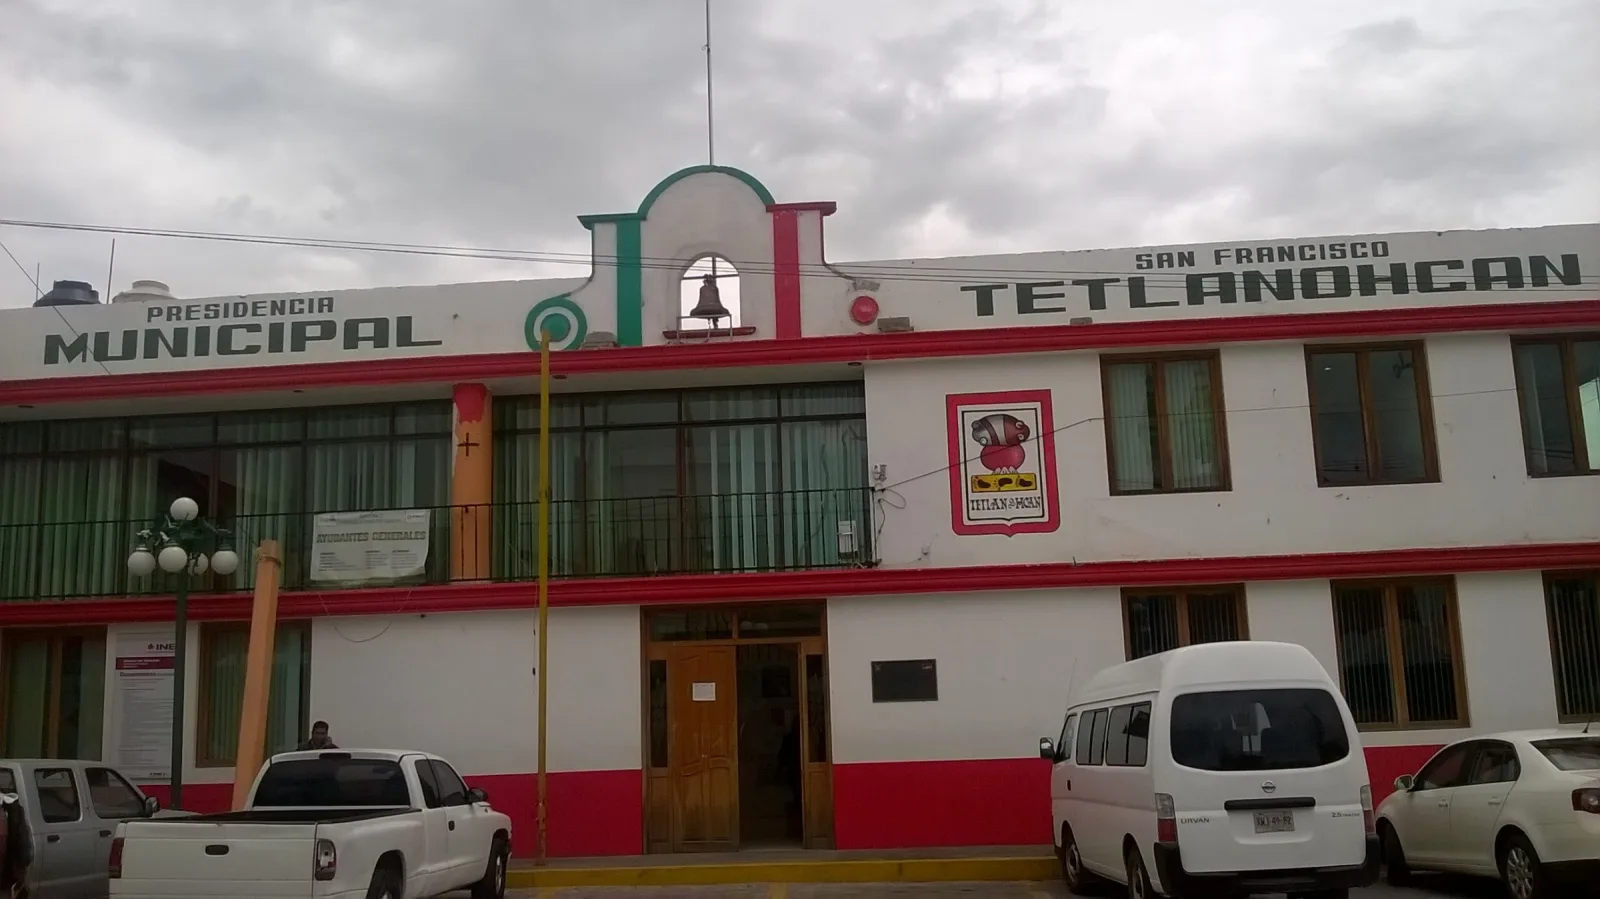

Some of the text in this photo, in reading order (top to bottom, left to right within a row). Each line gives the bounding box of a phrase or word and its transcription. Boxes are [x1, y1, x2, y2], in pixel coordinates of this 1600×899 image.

[1135, 240, 1391, 270] SAN FRANCISCO
[959, 253, 1582, 318] TETLANOHCAN
[146, 296, 335, 323] PRESIDENCIA
[43, 315, 443, 365] MUNICIPAL
[316, 530, 426, 544] AYUDANTES GENERALES
[155, 643, 175, 651] INE
